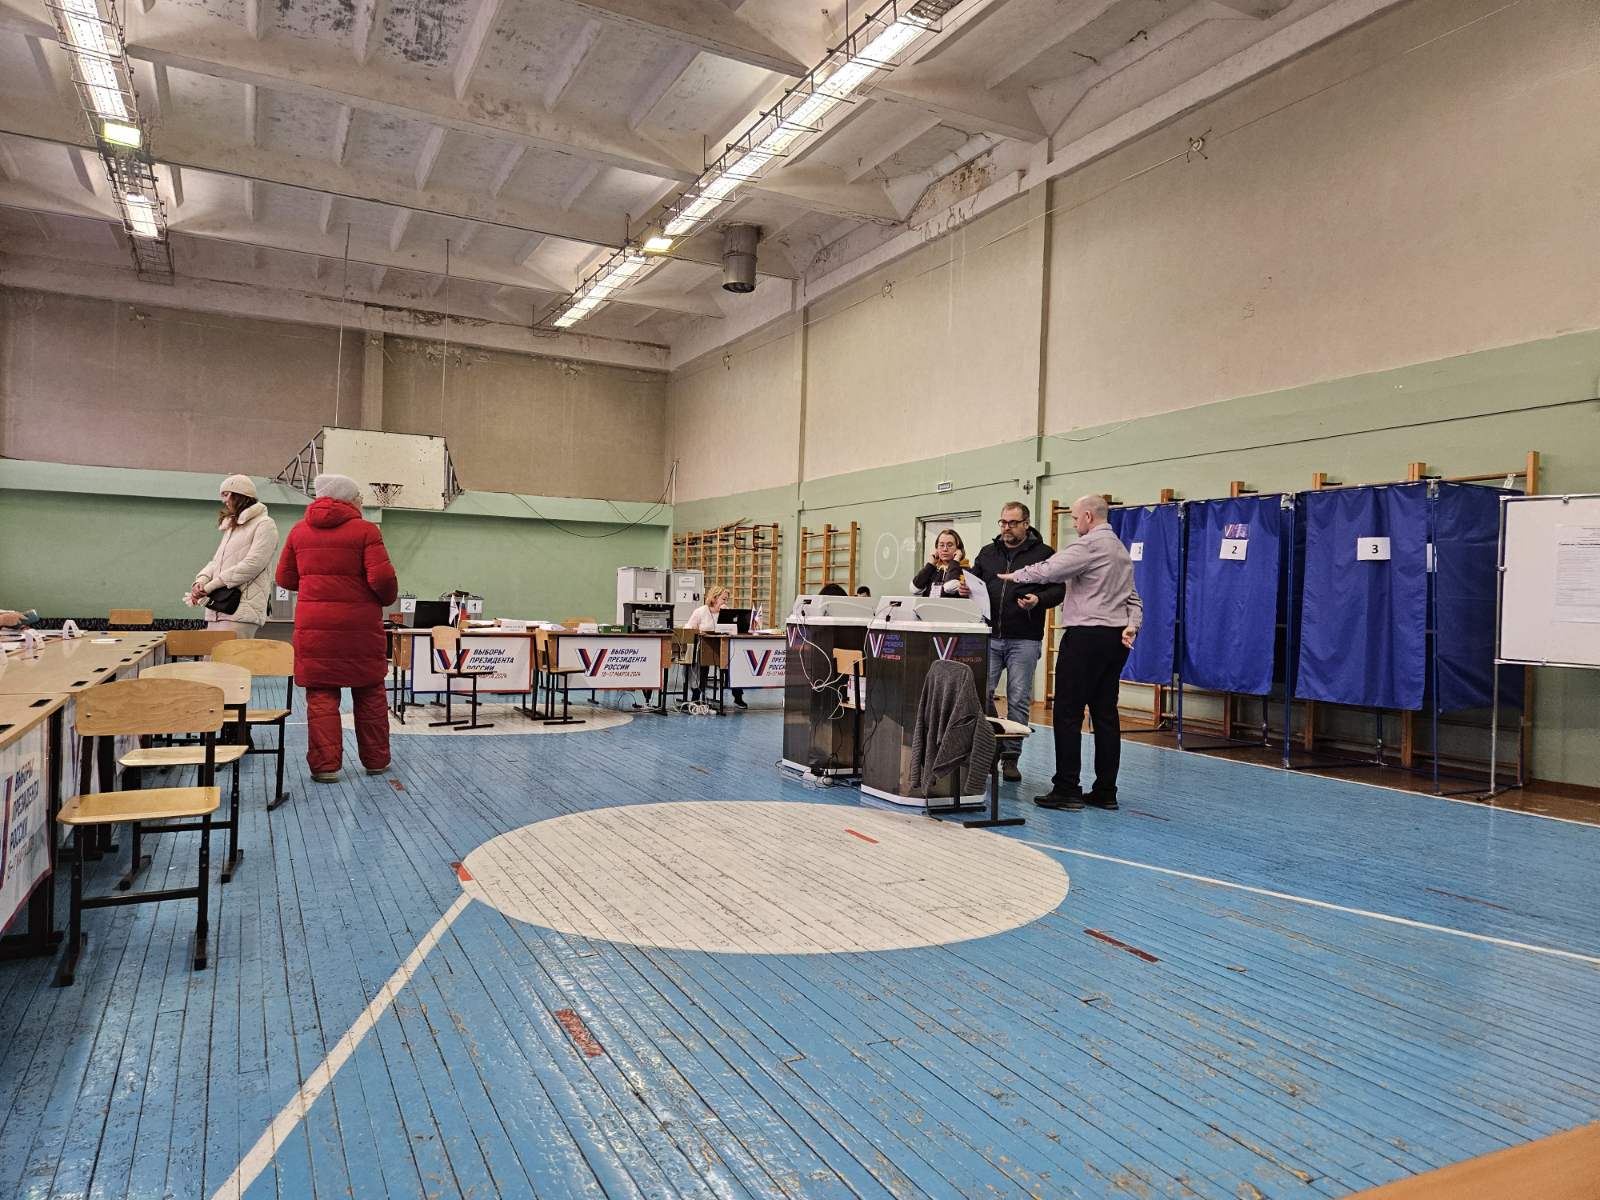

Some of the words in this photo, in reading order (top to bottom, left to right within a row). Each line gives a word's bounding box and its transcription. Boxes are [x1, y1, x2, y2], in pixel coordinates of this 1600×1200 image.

[1231, 545, 1238, 555] 2
[1371, 544, 1379, 554] 3
[280, 590, 286, 598] 2
[404, 601, 412, 611] 2
[471, 603, 477, 611] 1
[473, 648, 506, 656] ВЫБОРЫ
[469, 656, 515, 665] ПРЕЗИДЕНТА
